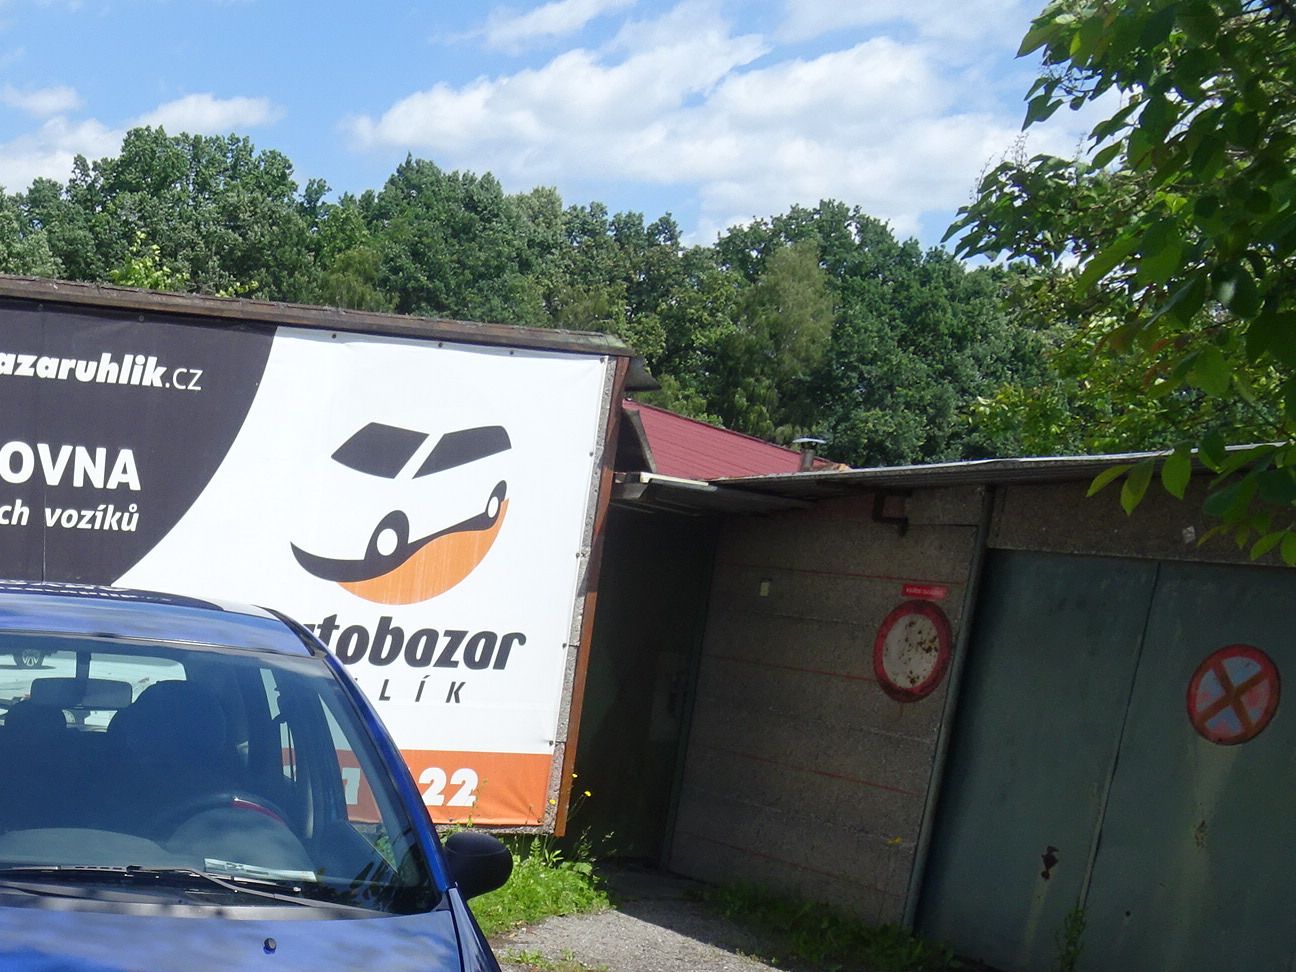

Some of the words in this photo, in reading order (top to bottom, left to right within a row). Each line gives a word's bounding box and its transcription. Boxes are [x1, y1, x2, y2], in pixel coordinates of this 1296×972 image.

[44, 503, 140, 532] vozíků
[304, 614, 527, 670] tobazar
[358, 675, 466, 704] LÍK
[415, 766, 479, 807] 22
